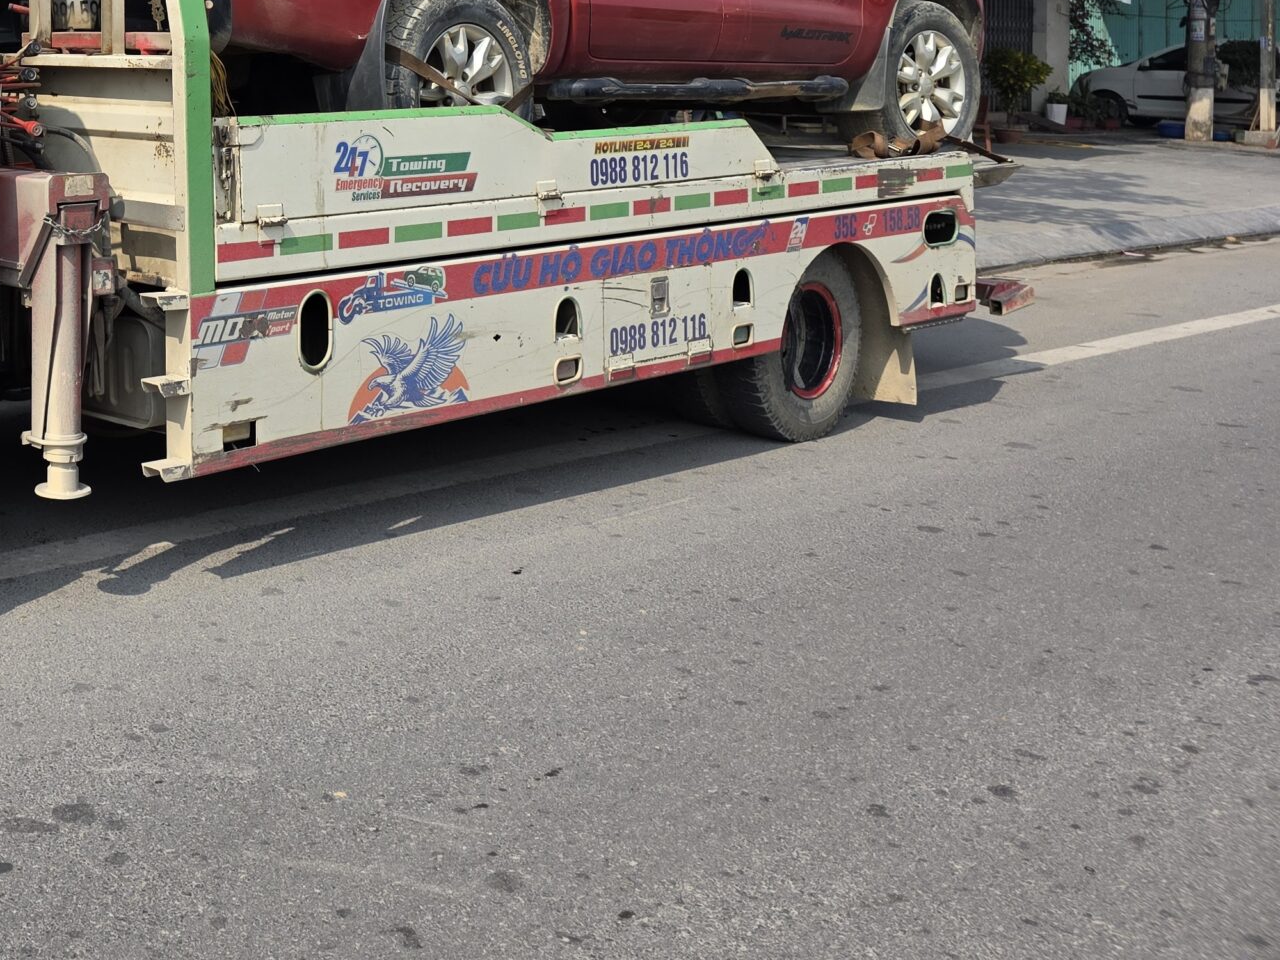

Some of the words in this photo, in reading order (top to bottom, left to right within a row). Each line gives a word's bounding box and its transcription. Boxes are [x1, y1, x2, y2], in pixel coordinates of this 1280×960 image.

[594, 140, 634, 154] HOTLINE
[388, 157, 446, 172] Towing
[590, 156, 628, 187] 0988
[631, 153, 660, 183] 812
[663, 151, 690, 180] 116
[336, 177, 384, 191] Emergency
[389, 178, 468, 193] Recovery
[351, 190, 381, 202] Services
[834, 214, 858, 240] 35C
[882, 205, 920, 233] 158.58
[589, 239, 657, 280] GIAO
[377, 294, 424, 310] TOWING
[267, 311, 295, 320] Motor
[265, 323, 290, 335] port
[610, 325, 647, 356] 0988
[651, 318, 678, 349] 812
[681, 312, 708, 343] 116
